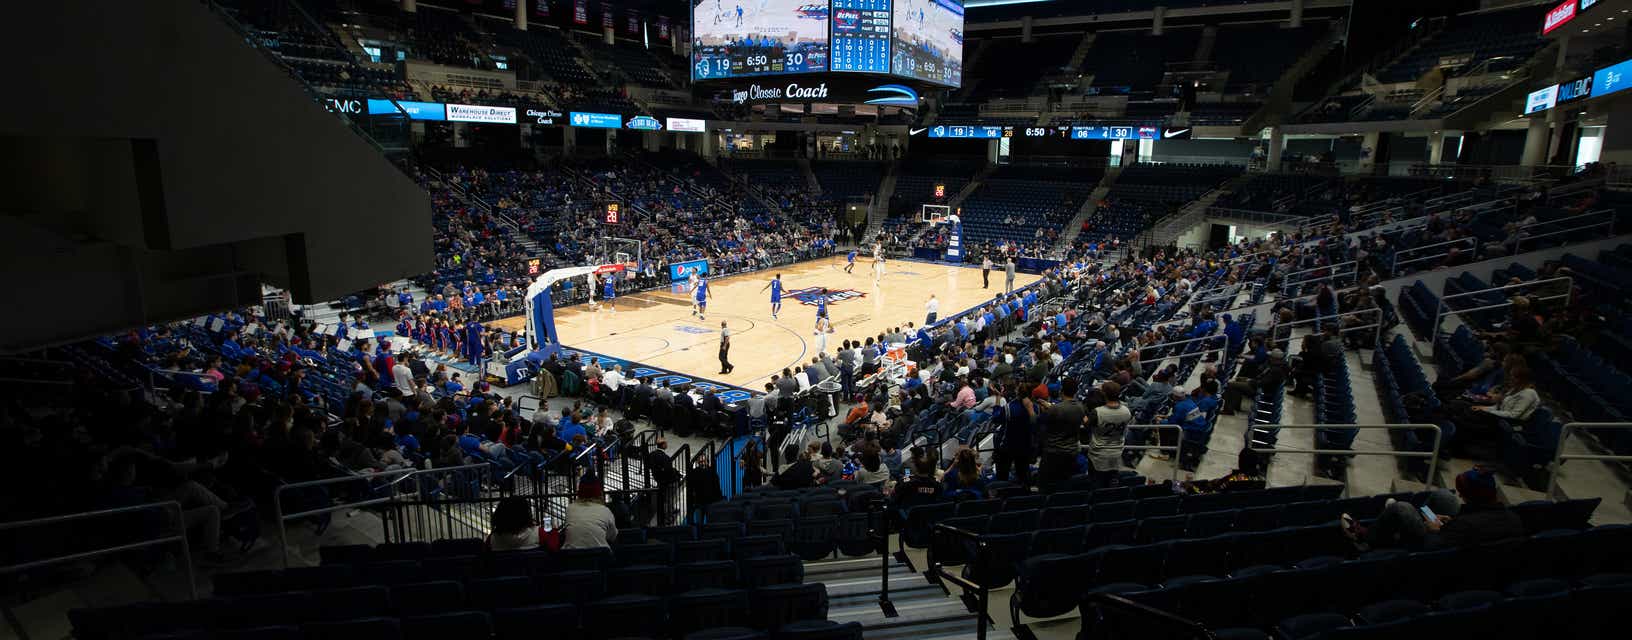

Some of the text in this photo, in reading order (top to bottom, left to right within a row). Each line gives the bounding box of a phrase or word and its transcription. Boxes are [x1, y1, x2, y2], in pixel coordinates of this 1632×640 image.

[716, 58, 730, 70] 19
[746, 56, 767, 66] 6:50
[786, 53, 803, 66] 30
[906, 58, 915, 70] 19
[944, 66, 952, 78] 30
[750, 84, 782, 100] Classic
[786, 83, 828, 98] Coach
[954, 128, 962, 136] 19
[1026, 128, 1045, 136] 6:50
[1115, 128, 1127, 137] 30
[607, 211, 617, 222] 28
